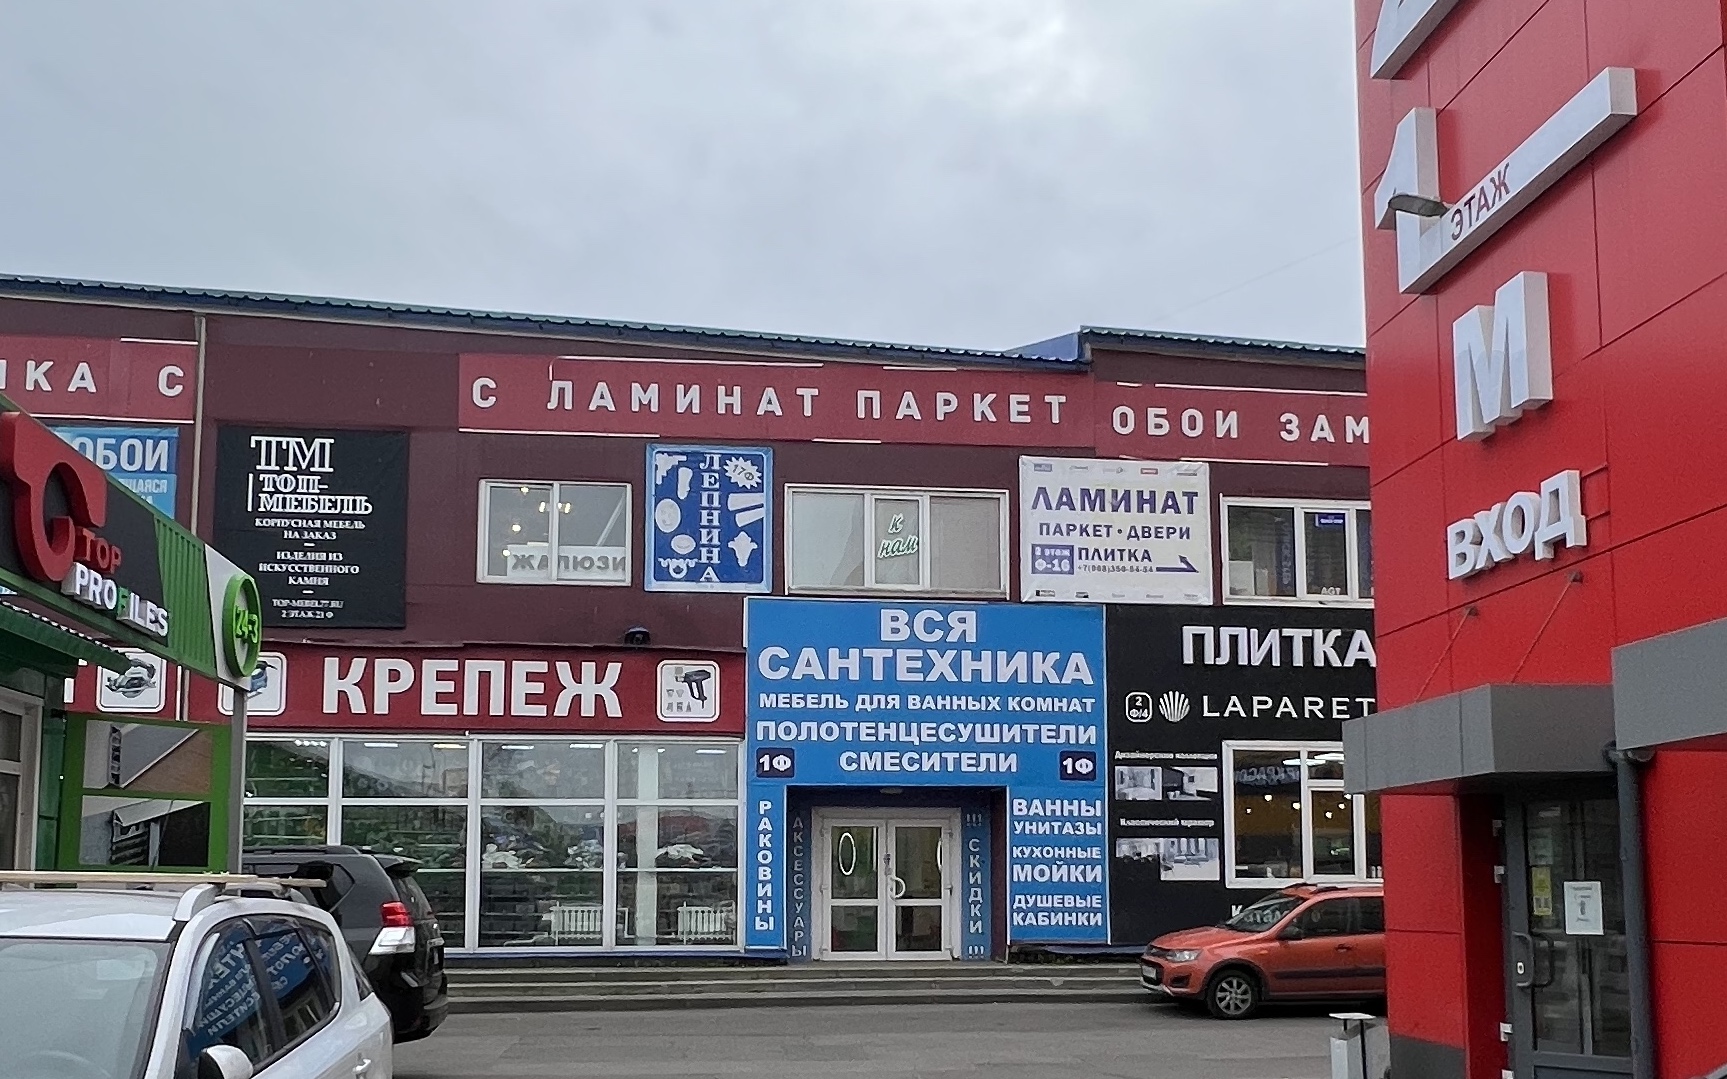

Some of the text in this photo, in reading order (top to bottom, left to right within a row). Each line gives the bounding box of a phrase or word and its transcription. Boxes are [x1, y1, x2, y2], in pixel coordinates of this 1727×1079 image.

[1450, 162, 1512, 241] ЭТАЖ
[158, 365, 184, 397] С
[472, 378, 497, 408] С
[547, 380, 819, 416] ЛАМИНАТ
[857, 390, 1066, 424] ПАРКЕТ
[1112, 405, 1238, 438] ОБОИ
[732, 464, 755, 481] 17Ф
[258, 493, 373, 515] МЕБЕЛЬ
[1031, 486, 1199, 515] ЛАМИНАТ
[255, 518, 365, 529] КОРПУСНАЯ МЕБЕЛЬ
[699, 454, 721, 582] ЛЕПНИНА
[1448, 470, 1587, 580] ВХОД
[283, 530, 337, 540] НА ЗАКАЗ
[1039, 523, 1190, 541] ПАРКЕТ ДВЕРИ
[79, 527, 122, 575] TOP
[276, 551, 343, 561] ИЗДЕЛИЯ ИЗ
[1078, 547, 1152, 562] ПЛИТКА
[258, 563, 359, 574] ИСКУССТВЕННОГО
[288, 575, 329, 586] КАМНЯ
[72, 562, 169, 637] PROFILES
[880, 609, 977, 643] ВСЯ
[1182, 625, 1377, 668] ПЛИТКА
[757, 647, 1094, 685] САНТЕХНИКА
[322, 657, 623, 718] КРЕПЕЖ
[759, 693, 1096, 713] МЕБЕЛЬ ДЛЯ ВАННЫХ КОМНАТ
[1135, 696, 1142, 706] 2
[1203, 696, 1376, 718] LAPARET
[756, 720, 1097, 745] ПОЛОТЕНЦЕСУШИТЕЛИ
[759, 751, 1094, 775] 1Ф СМЕСИТЕЛИ 1Ф
[1012, 799, 1102, 817] ВАННЫ
[1013, 821, 1102, 835] УНИТАЗЫ
[1012, 845, 1102, 859] КУХОННЫЕ
[755, 800, 774, 931] РАКОВИНЫ
[1012, 861, 1102, 883] МОЙКИ
[791, 816, 807, 957] АКСЕССУАРЫ
[968, 838, 984, 934] СКИДКИ
[1013, 894, 1102, 910] ДУШЕВЫЕ
[1012, 912, 1102, 927] КАБИНКИ
